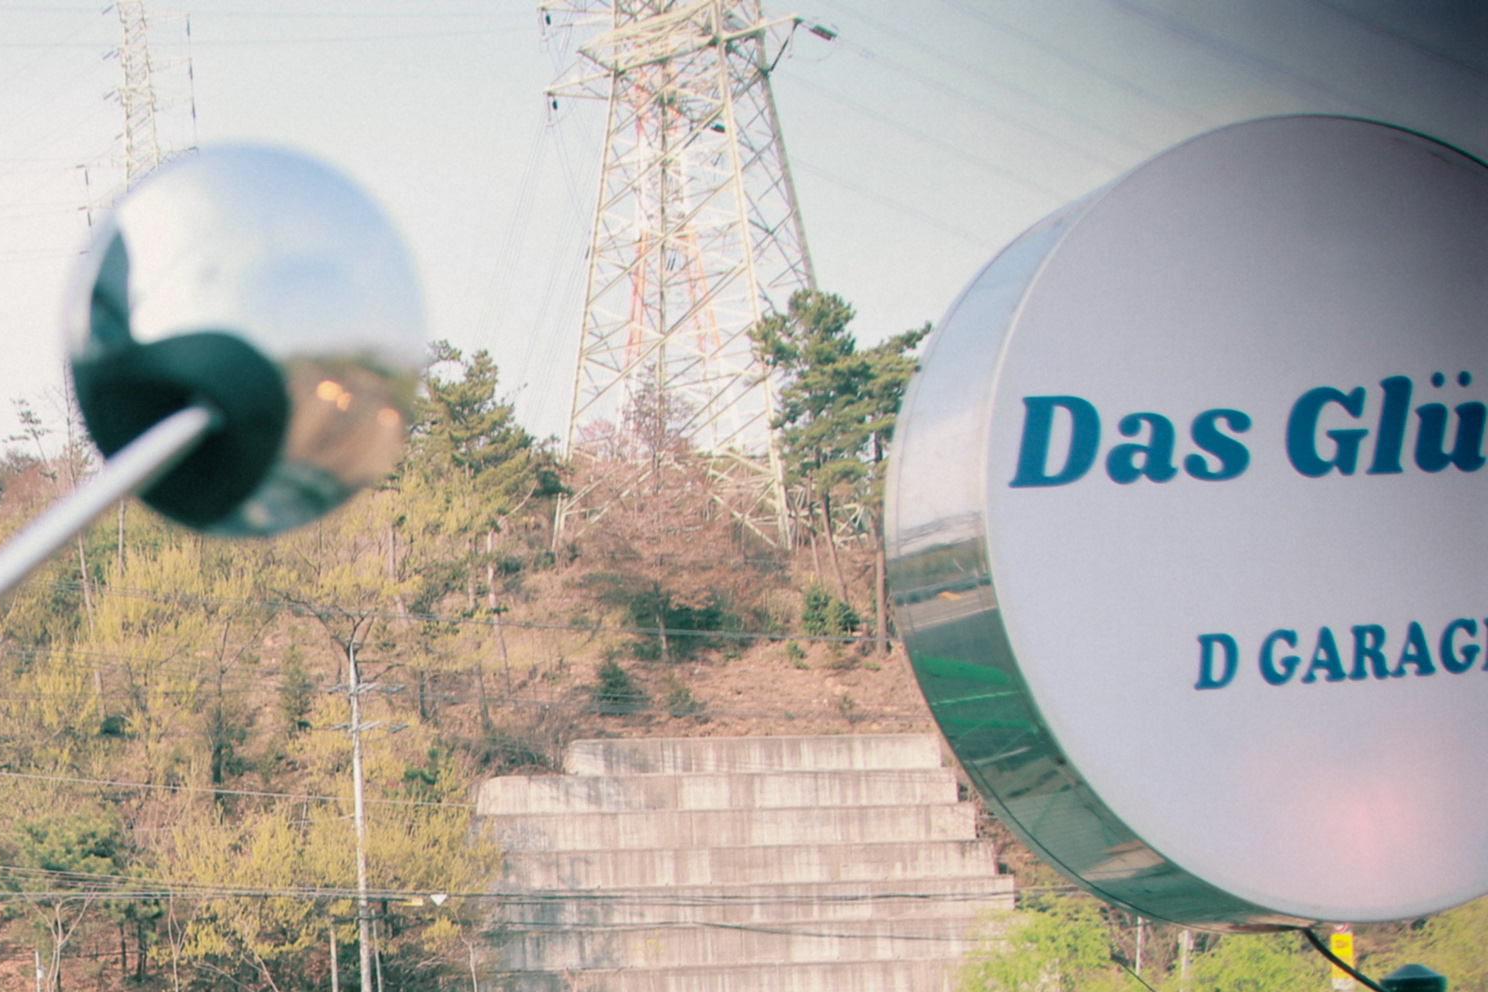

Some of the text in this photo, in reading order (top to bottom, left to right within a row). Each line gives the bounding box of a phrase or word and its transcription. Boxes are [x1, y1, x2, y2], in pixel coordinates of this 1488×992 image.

[1008, 370, 1488, 488] Das Glü
[1194, 617, 1488, 691] D GARAG
